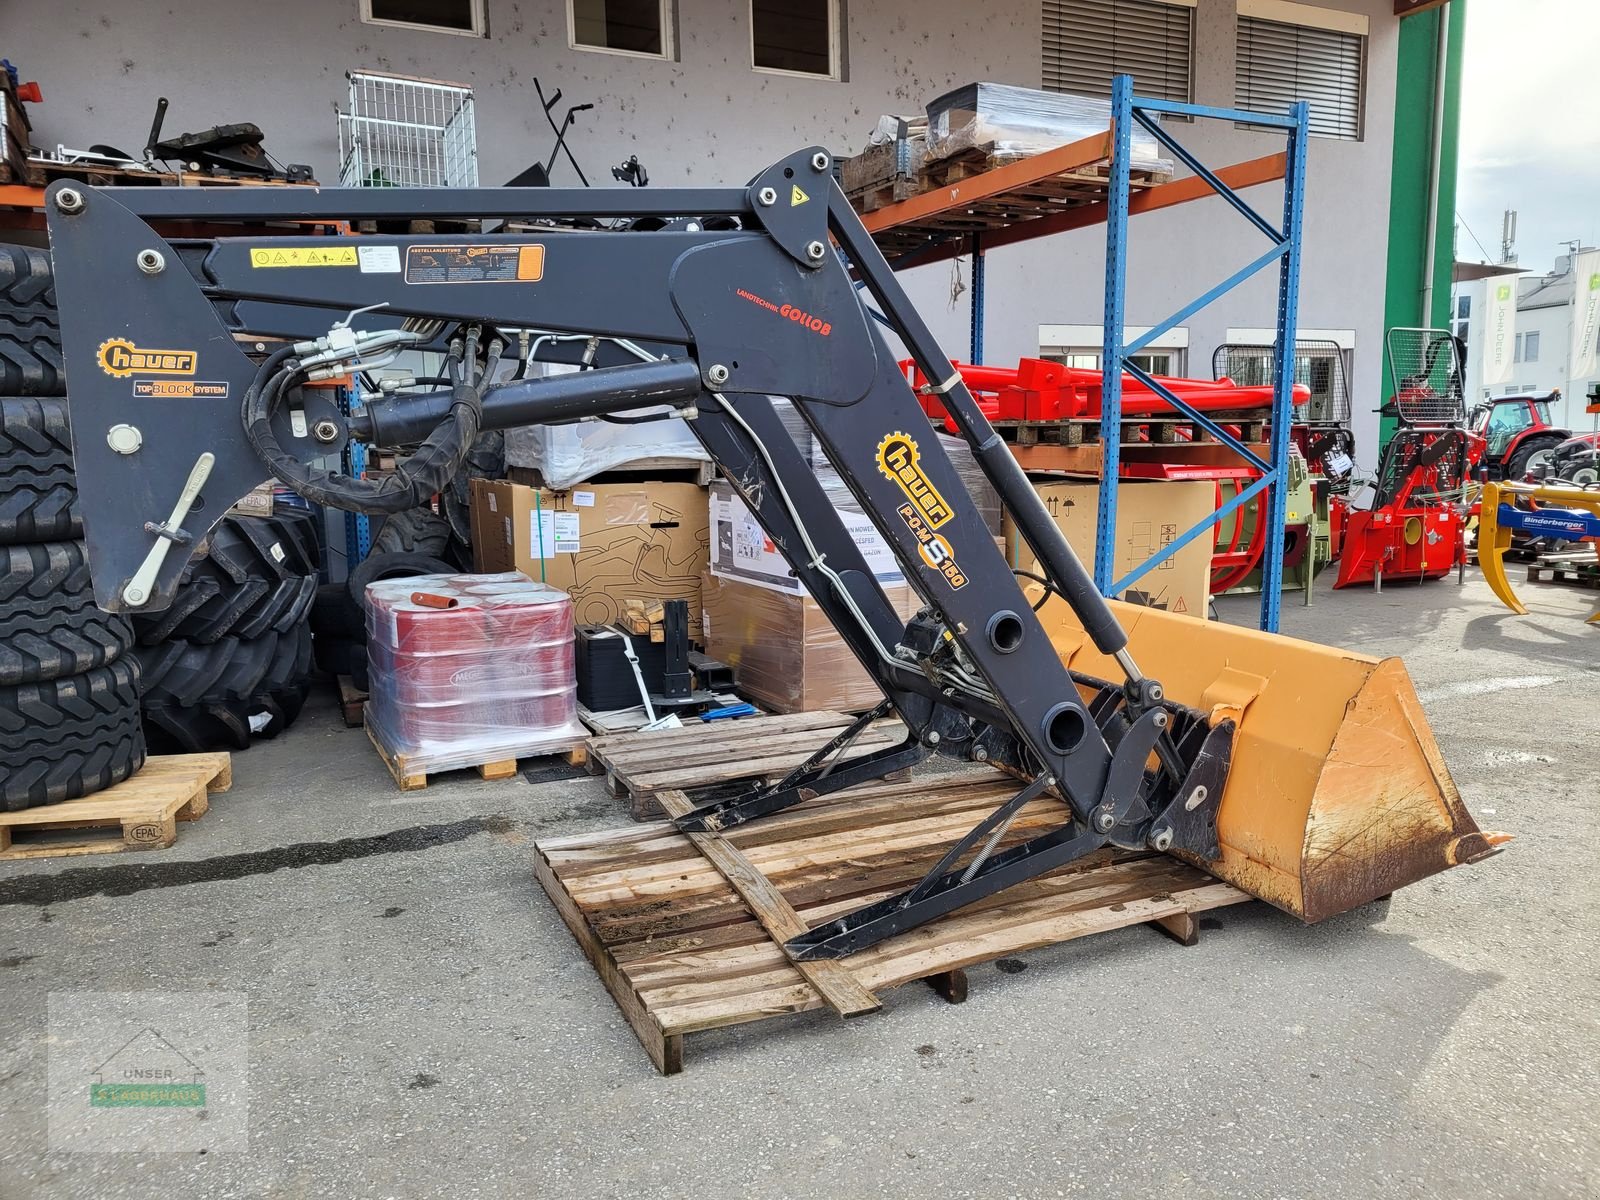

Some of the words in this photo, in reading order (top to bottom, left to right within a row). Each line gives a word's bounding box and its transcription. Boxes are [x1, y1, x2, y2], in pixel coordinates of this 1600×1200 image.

[736, 288, 779, 313] LANDTECHNIK
[780, 304, 832, 336] GOLLOB
[1497, 306, 1505, 332] JOHN
[112, 347, 190, 369] hauer
[886, 445, 947, 522] hauer
[1524, 516, 1584, 528] Binderberger
[940, 559, 965, 587] 150
[136, 828, 159, 838] EPAL
